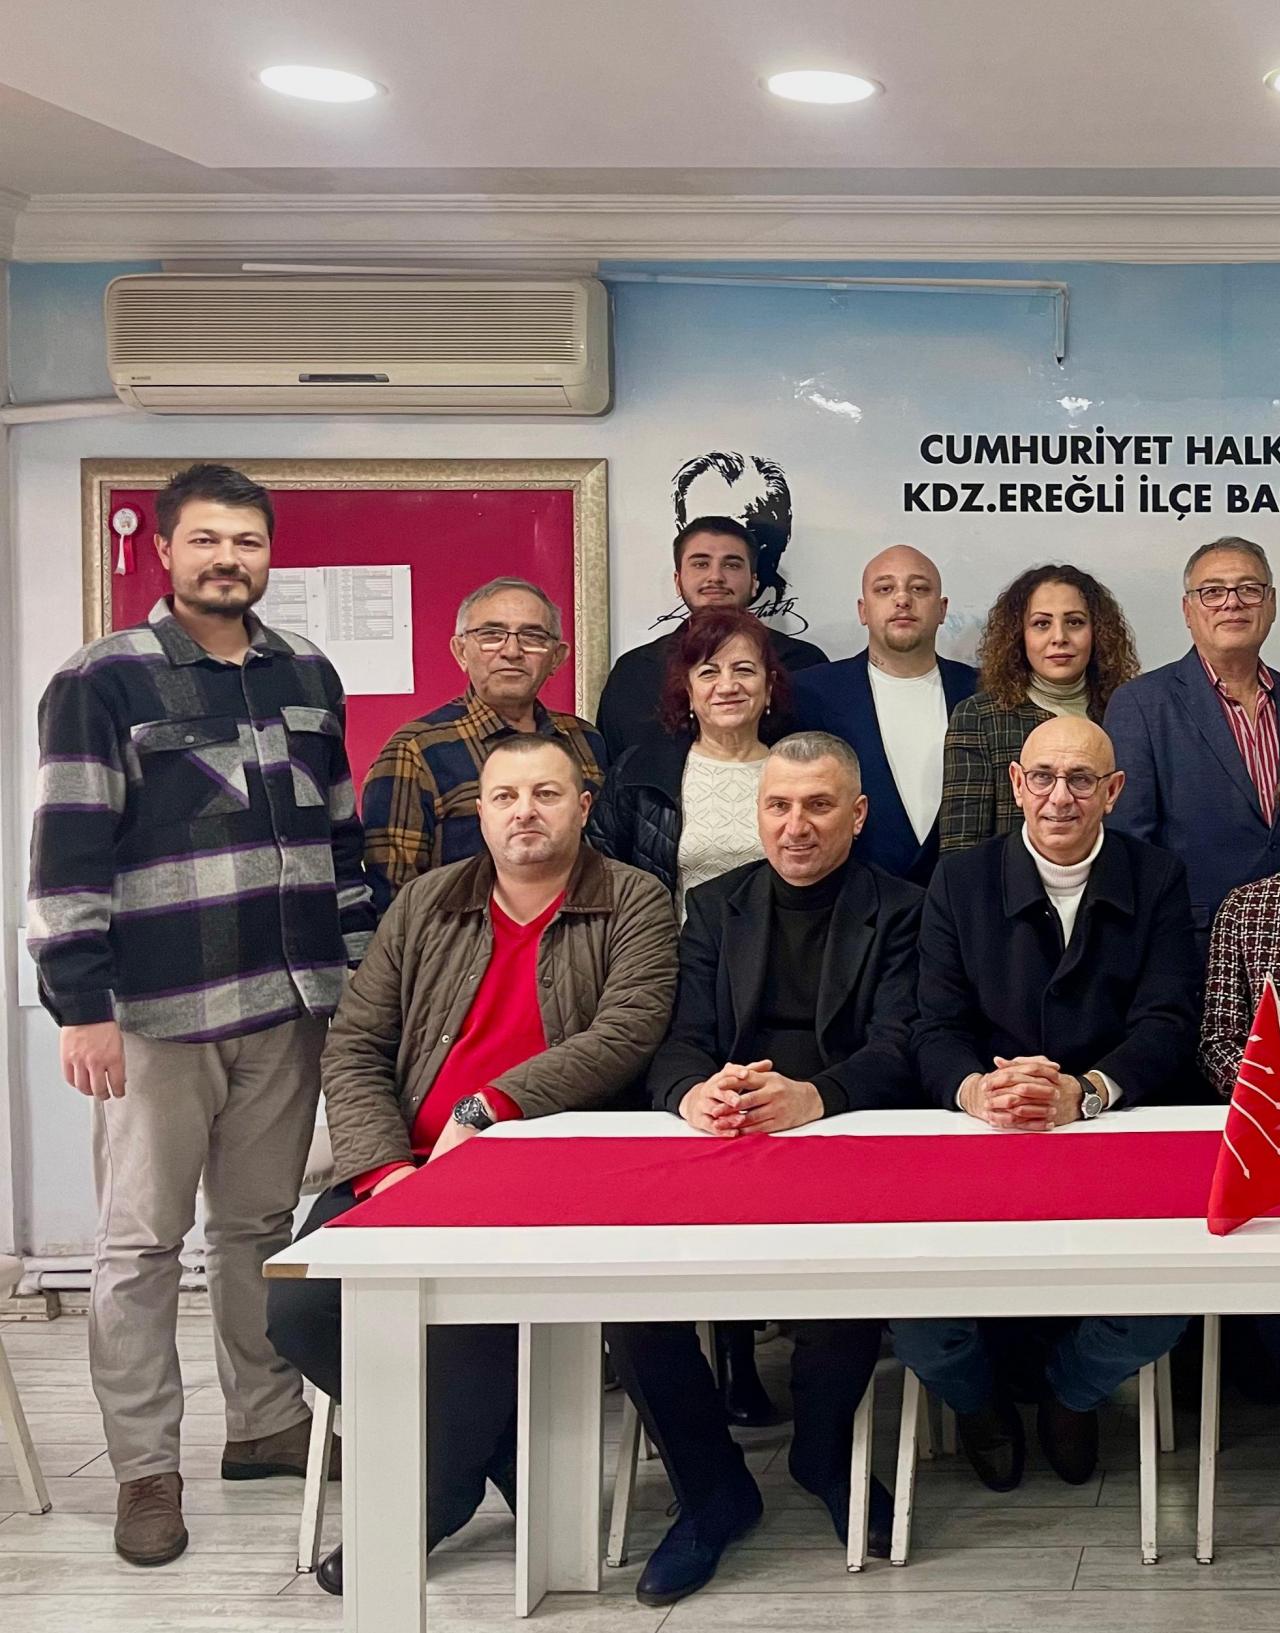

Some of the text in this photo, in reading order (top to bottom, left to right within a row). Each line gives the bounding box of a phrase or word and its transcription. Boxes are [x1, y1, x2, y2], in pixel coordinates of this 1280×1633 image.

[920, 425, 1173, 465] CUMHURİYET
[903, 474, 1124, 514] KDZ.EREĞLİ
[1139, 474, 1212, 521] İLÇE
